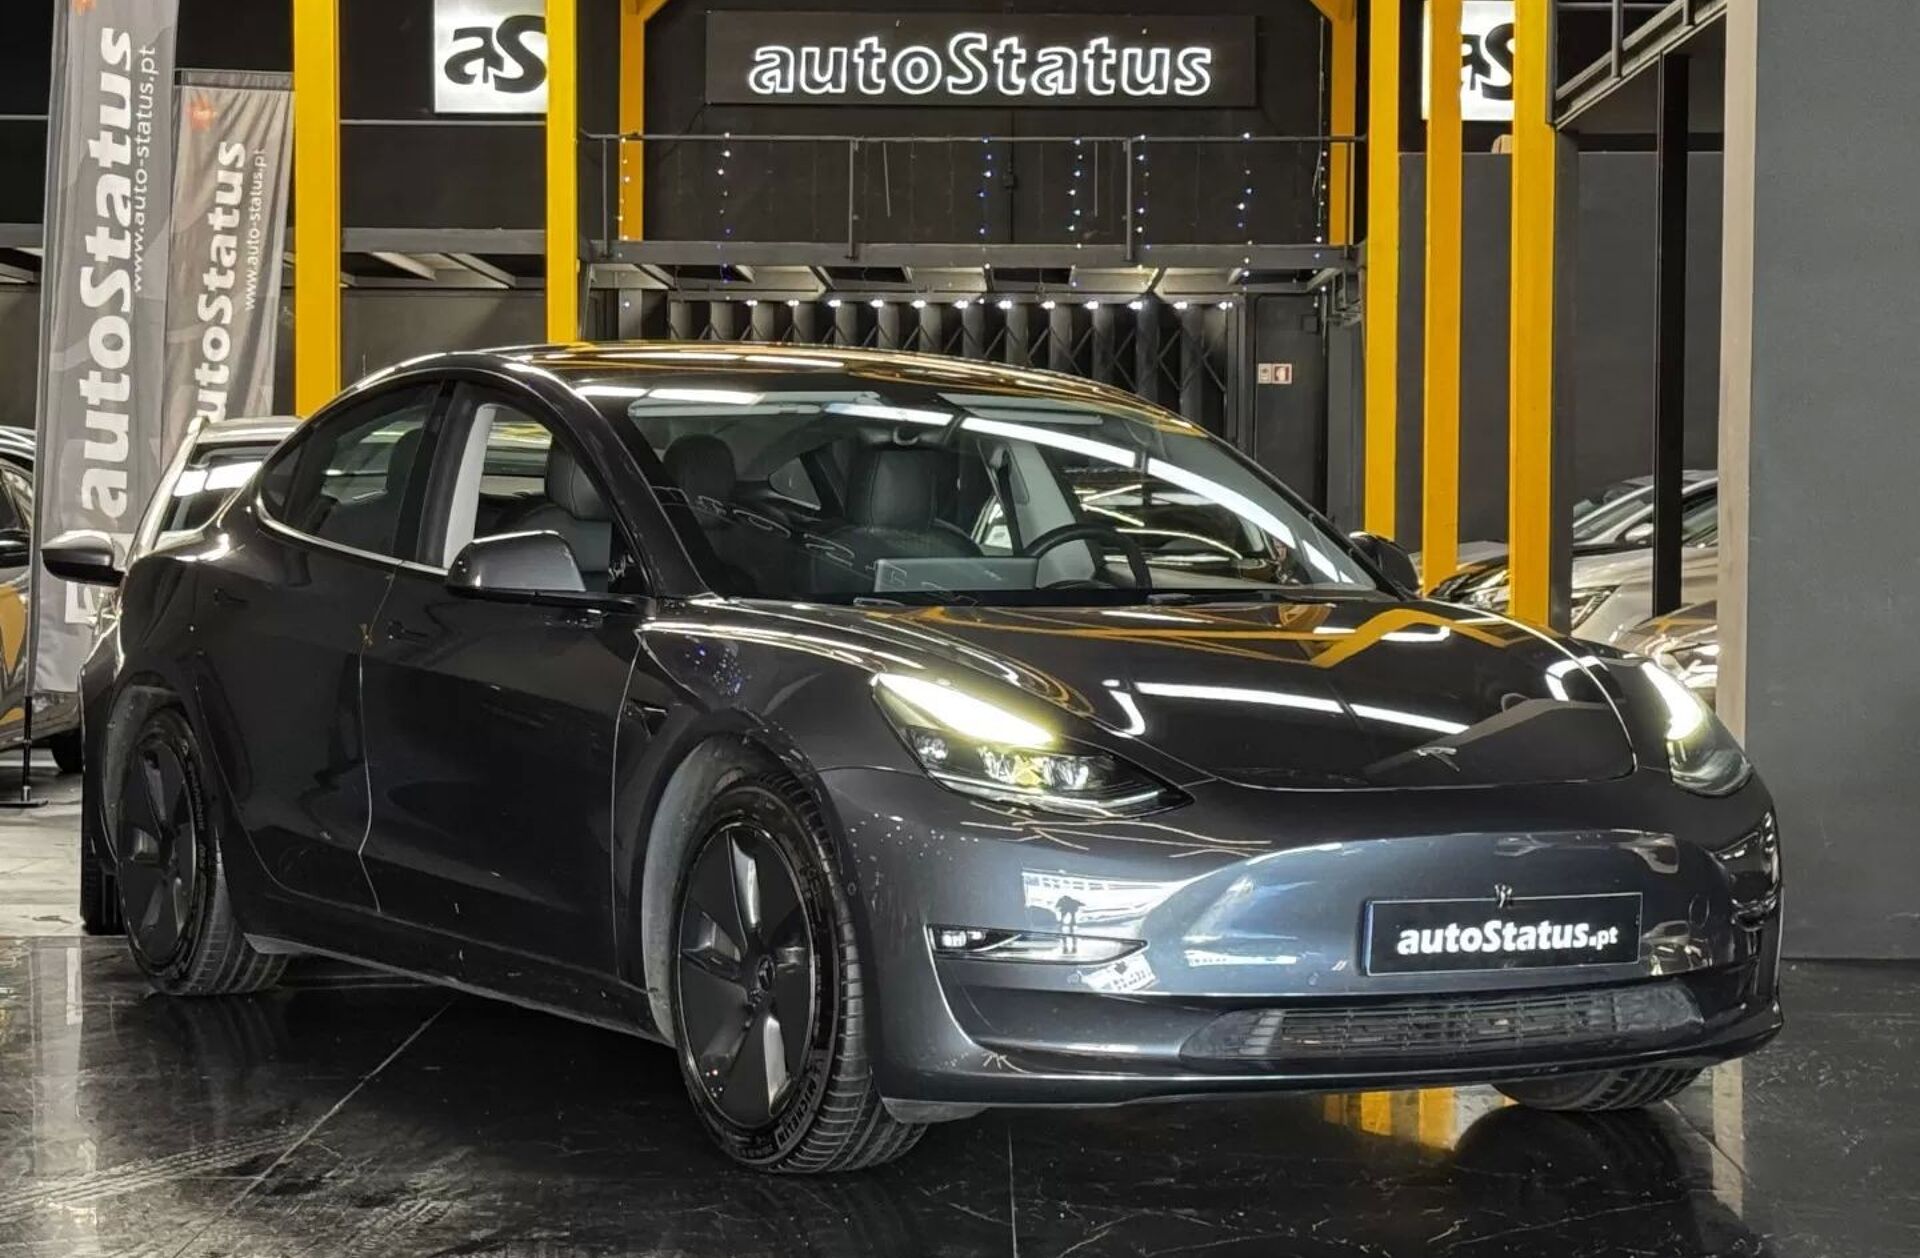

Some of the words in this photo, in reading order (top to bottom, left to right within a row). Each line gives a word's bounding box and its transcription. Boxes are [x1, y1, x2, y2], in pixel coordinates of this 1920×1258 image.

[748, 32, 1214, 97] autoStatus
[133, 45, 160, 293] www.auto-status.pt
[245, 148, 268, 311] www.auto-status.pt
[79, 27, 132, 519] autoStatus
[194, 141, 246, 424] utoStatus
[1397, 919, 1619, 955] autoStatus.pt
